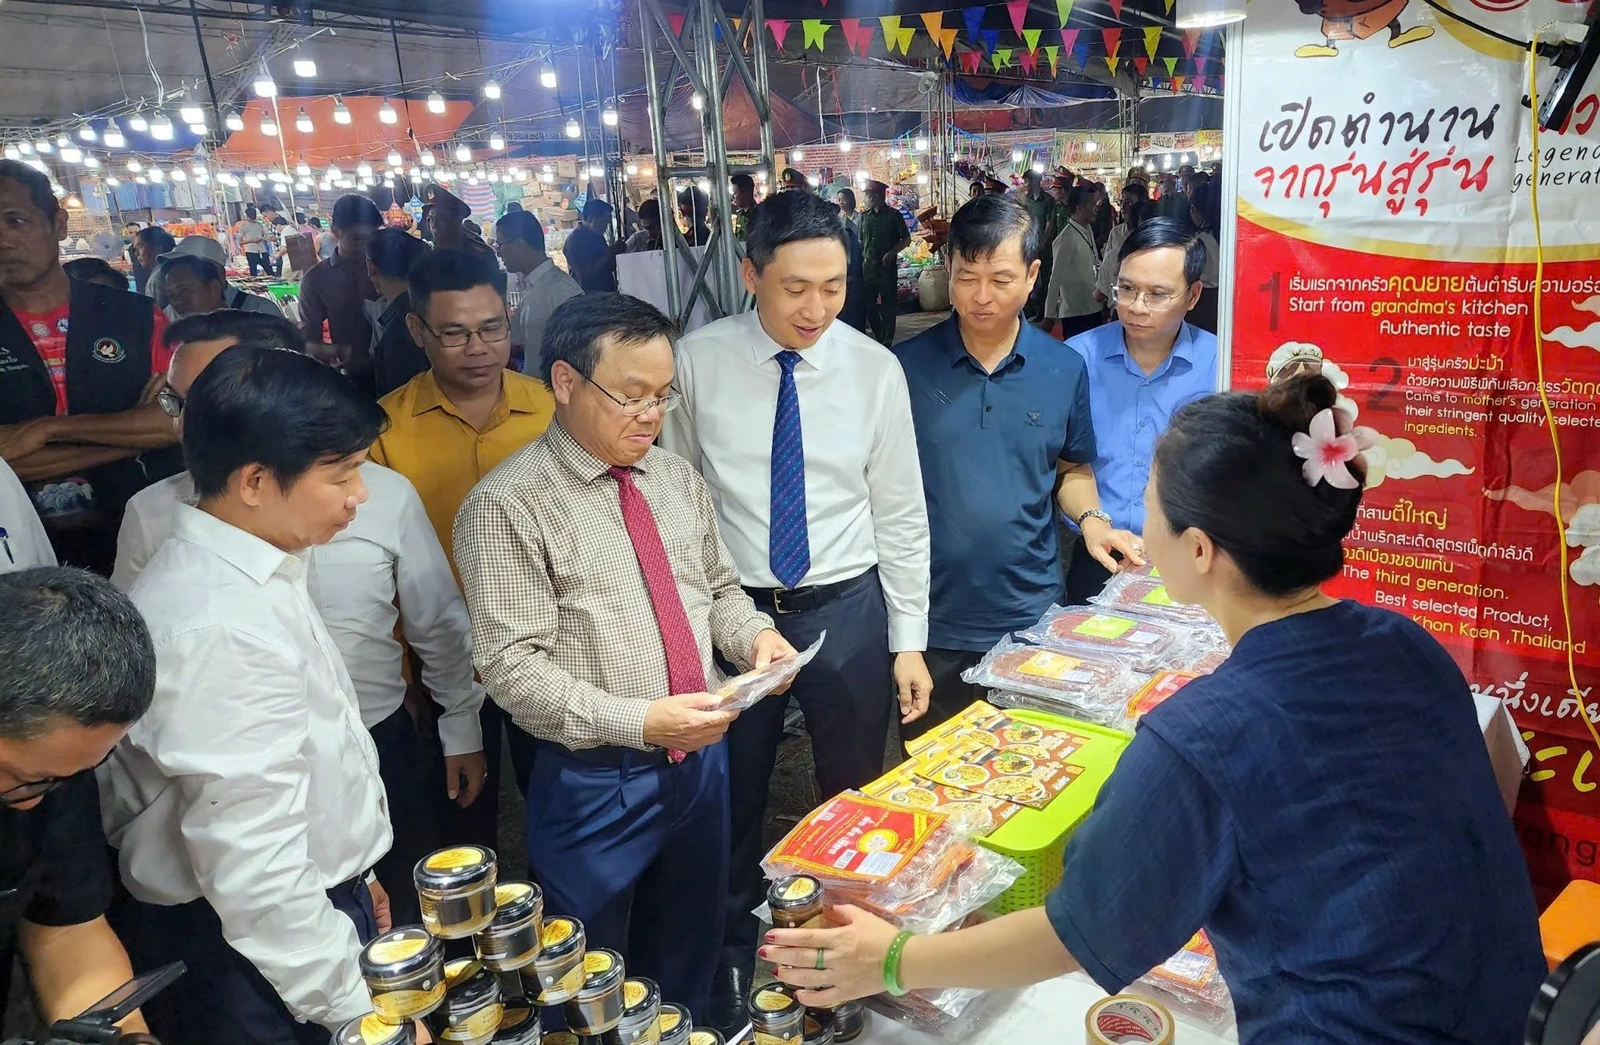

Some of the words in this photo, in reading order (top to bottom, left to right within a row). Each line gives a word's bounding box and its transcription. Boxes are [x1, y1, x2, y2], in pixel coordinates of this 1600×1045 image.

[1259, 92, 1500, 152] เปิดตำนาน
[1254, 145, 1495, 218] จากรุ่นสู่รุ่น
[1259, 272, 1280, 331] 1
[1289, 297, 1325, 312] Start
[1331, 297, 1365, 312] from
[1371, 299, 1456, 316] grandma's
[1462, 299, 1528, 315] kitchen
[1379, 320, 1461, 337] Authentic
[1468, 321, 1511, 337] taste
[1367, 357, 1401, 412] 2
[1405, 390, 1440, 403] Came
[1446, 392, 1458, 403] to
[1463, 394, 1516, 406] mother's
[1521, 398, 1596, 410] generation
[1404, 421, 1477, 437] ingredients.
[1405, 405, 1433, 417] their
[1437, 407, 1493, 422] stringent
[1498, 411, 1546, 427] quality
[1342, 564, 1369, 579] The
[1375, 567, 1410, 587] third
[1416, 577, 1509, 600] generation.
[1375, 590, 1407, 607] Best
[1412, 598, 1477, 620] selected
[1483, 607, 1553, 631] Product,
[1412, 614, 1454, 634] Khon
[1459, 622, 1500, 641] Kaen
